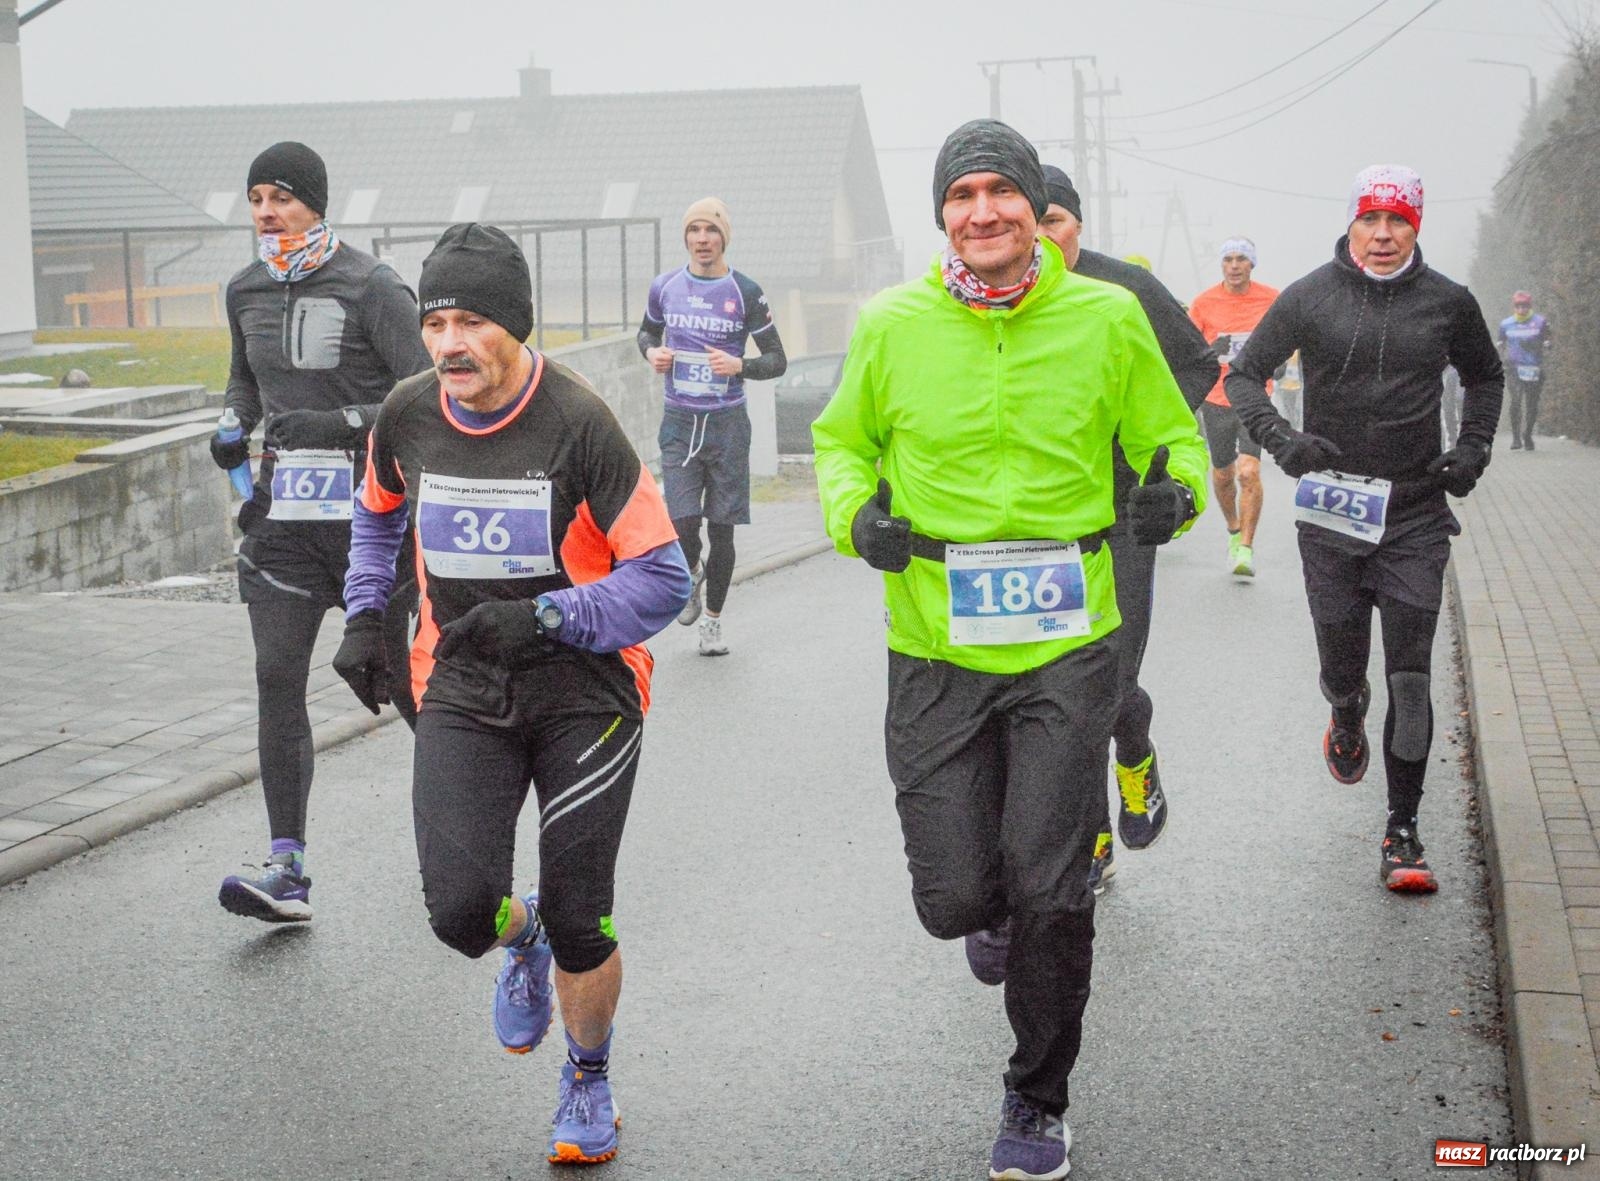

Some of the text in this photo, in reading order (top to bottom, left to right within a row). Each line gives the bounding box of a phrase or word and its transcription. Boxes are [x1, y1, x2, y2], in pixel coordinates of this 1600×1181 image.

[424, 298, 456, 310] KALENJI
[663, 313, 744, 332] UNNERS
[687, 364, 713, 383] 58
[281, 469, 337, 499] 167
[444, 485, 461, 493] Cross
[1311, 485, 1369, 521] 125
[453, 509, 511, 553] 36
[972, 567, 1063, 614] 186
[576, 715, 622, 765] NORTHFINDER
